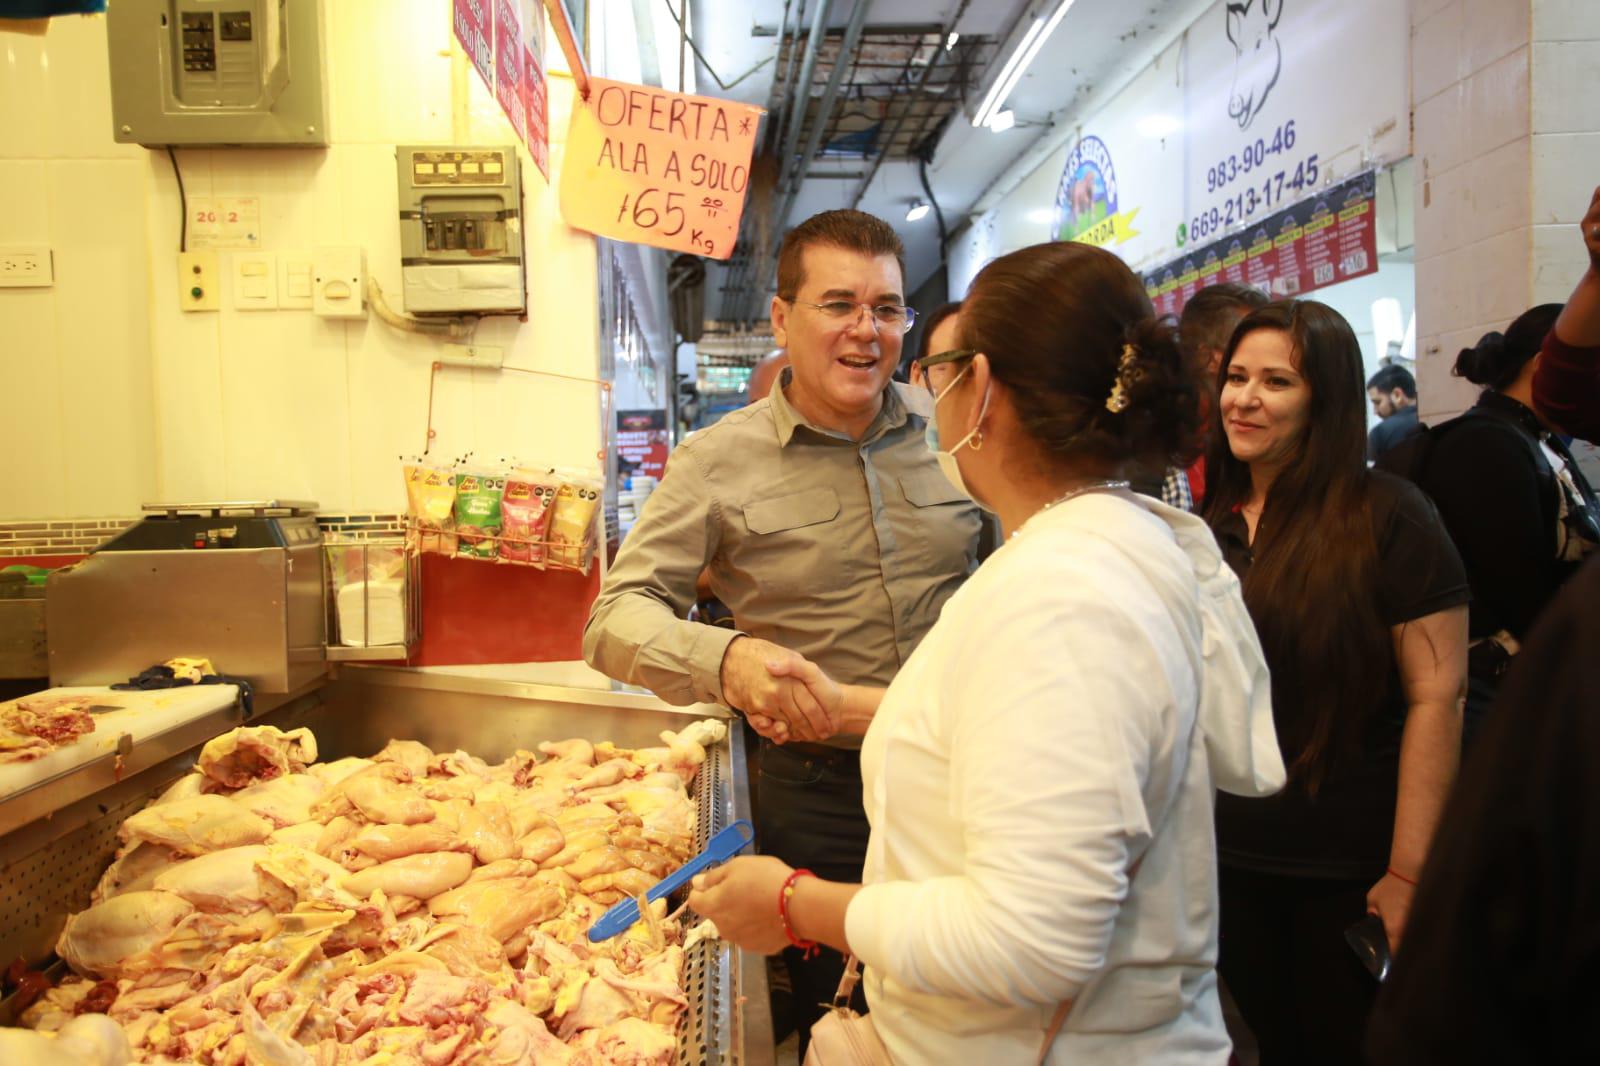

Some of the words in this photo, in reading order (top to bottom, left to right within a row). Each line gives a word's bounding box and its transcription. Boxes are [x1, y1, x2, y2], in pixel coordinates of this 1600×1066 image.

[597, 86, 731, 142] OFERTA
[597, 137, 650, 176] ALA
[664, 150, 683, 182] A
[690, 152, 748, 194] SOLO
[1207, 119, 1297, 193] 983-90-46
[1190, 154, 1320, 242] 669-213-17-45
